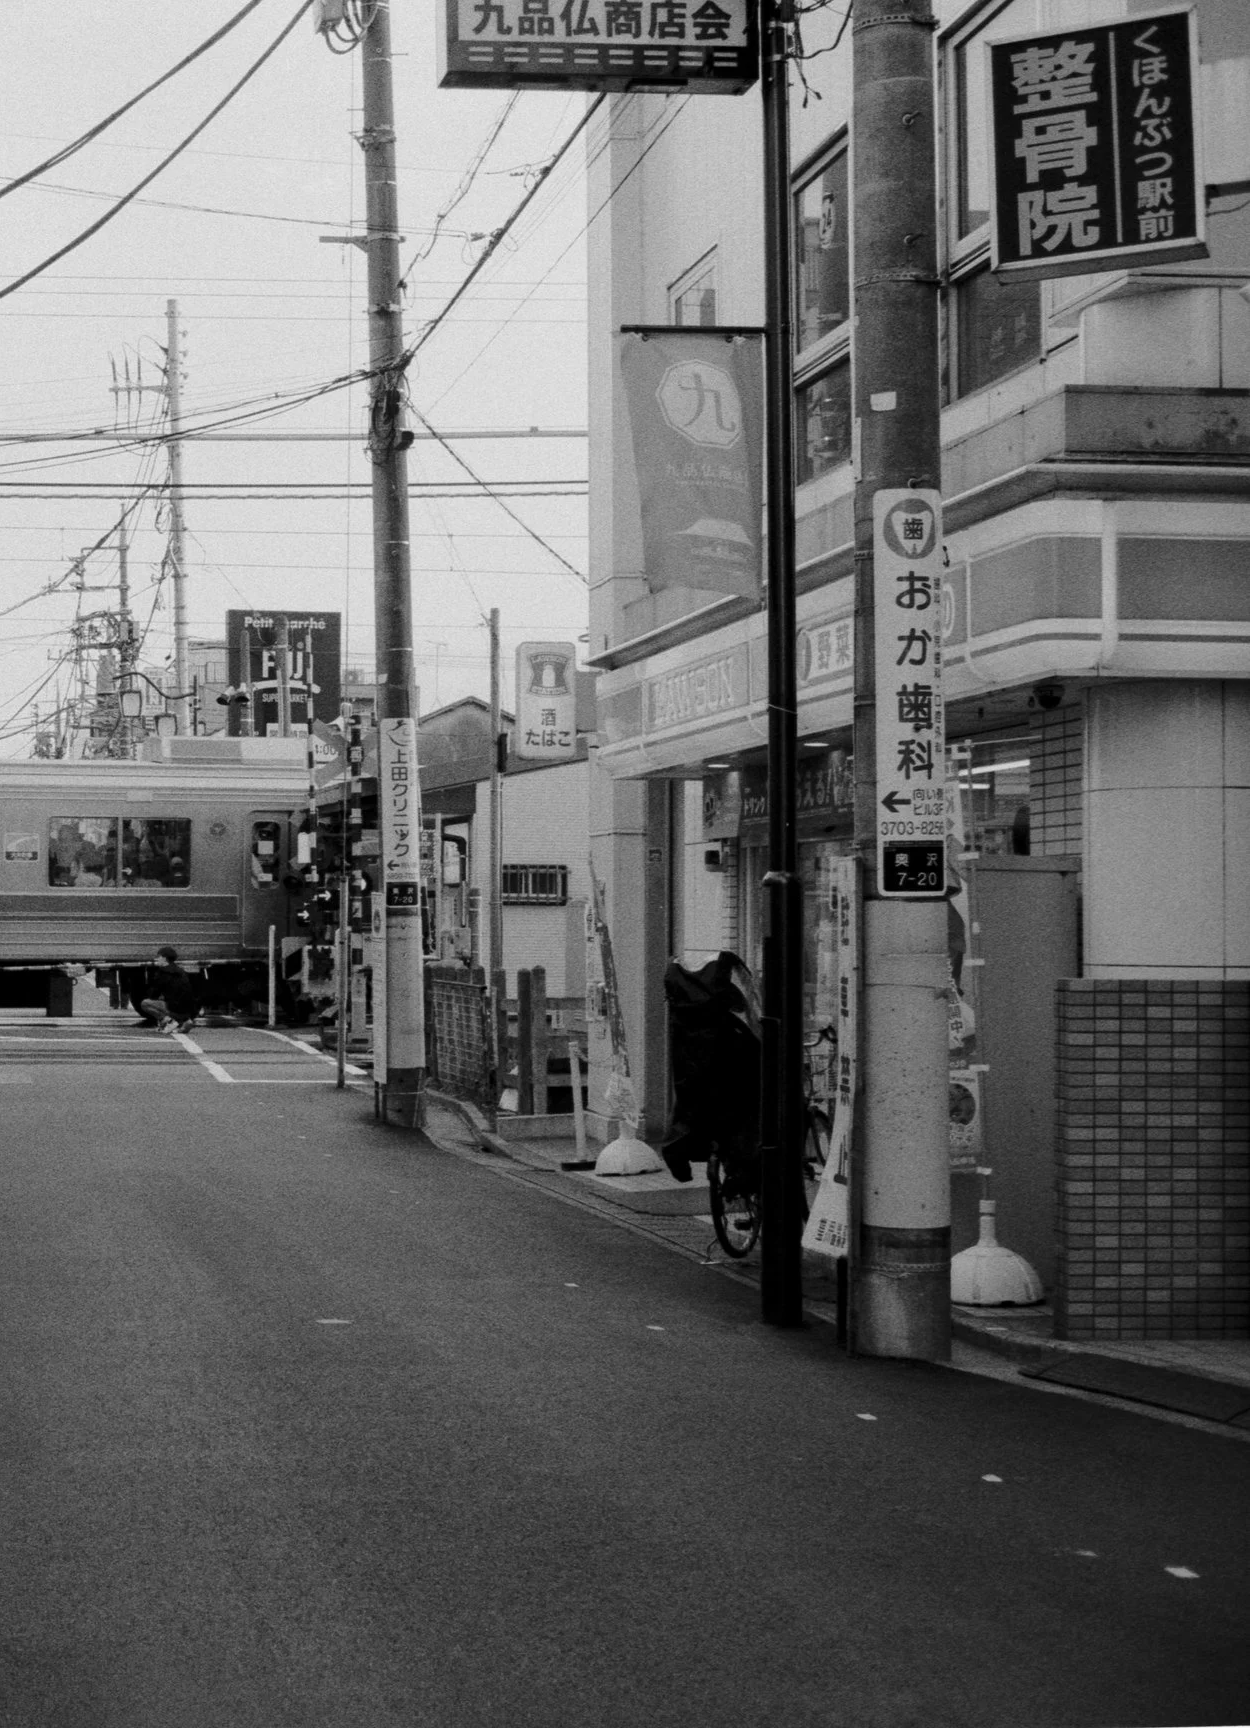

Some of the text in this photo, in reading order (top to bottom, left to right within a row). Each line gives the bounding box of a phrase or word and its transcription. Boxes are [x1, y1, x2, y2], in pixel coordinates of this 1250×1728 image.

[472, 0, 733, 41] 九品仏商店会
[1009, 40, 1101, 257] 整骨院
[1132, 25, 1175, 241] くほんぶつ駅前
[903, 517, 924, 541] 歯
[286, 617, 326, 629] arché
[894, 570, 934, 781] おか歯科
[540, 708, 557, 727] 酒
[390, 749, 410, 858] 上田クリニック
[897, 871, 937, 886] 7-20
[393, 896, 414, 904] 7-20
